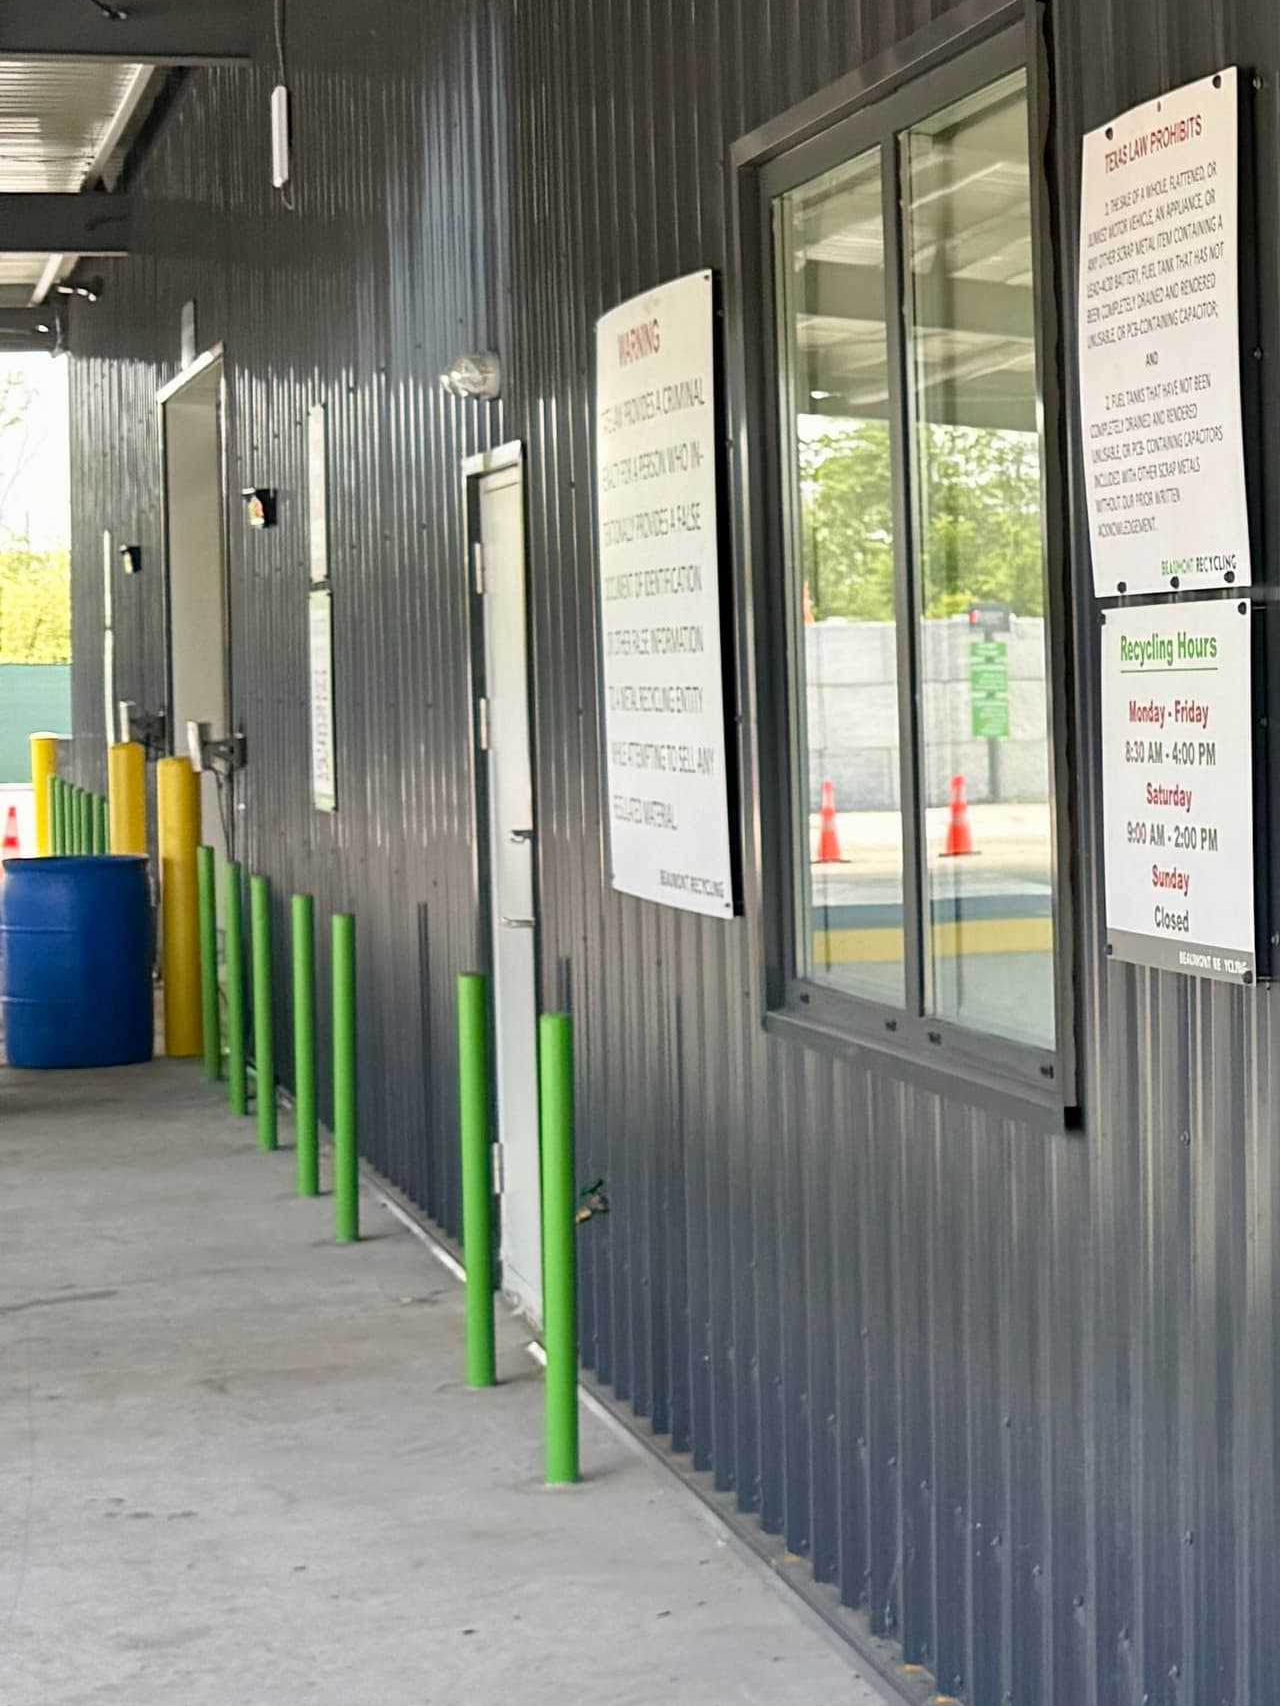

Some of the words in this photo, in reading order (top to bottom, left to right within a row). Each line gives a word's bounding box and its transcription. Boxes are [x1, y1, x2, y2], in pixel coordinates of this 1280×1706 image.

[1105, 145, 1127, 172] TEXAS
[1129, 136, 1148, 161] LAW
[1150, 115, 1201, 152] PROHIBITS
[618, 319, 660, 364] WARNING
[1145, 351, 1158, 365] AND
[1196, 555, 1236, 572] RECYCLING
[1121, 634, 1173, 666] Recycling
[1177, 632, 1217, 658] Hours
[1129, 701, 1165, 728] Monday
[1175, 701, 1208, 729] Friday
[1126, 741, 1145, 763] 8:30
[1148, 742, 1163, 763] AM
[1172, 742, 1195, 765] 4:00
[1199, 743, 1216, 765] PM
[1147, 783, 1192, 813] Saturday
[1127, 821, 1146, 844] 9:00
[1150, 824, 1165, 846] AM
[1174, 826, 1196, 849] 2:00
[1200, 828, 1218, 851] PM
[1152, 865, 1189, 896] Sunday
[1155, 906, 1189, 932] Closed
